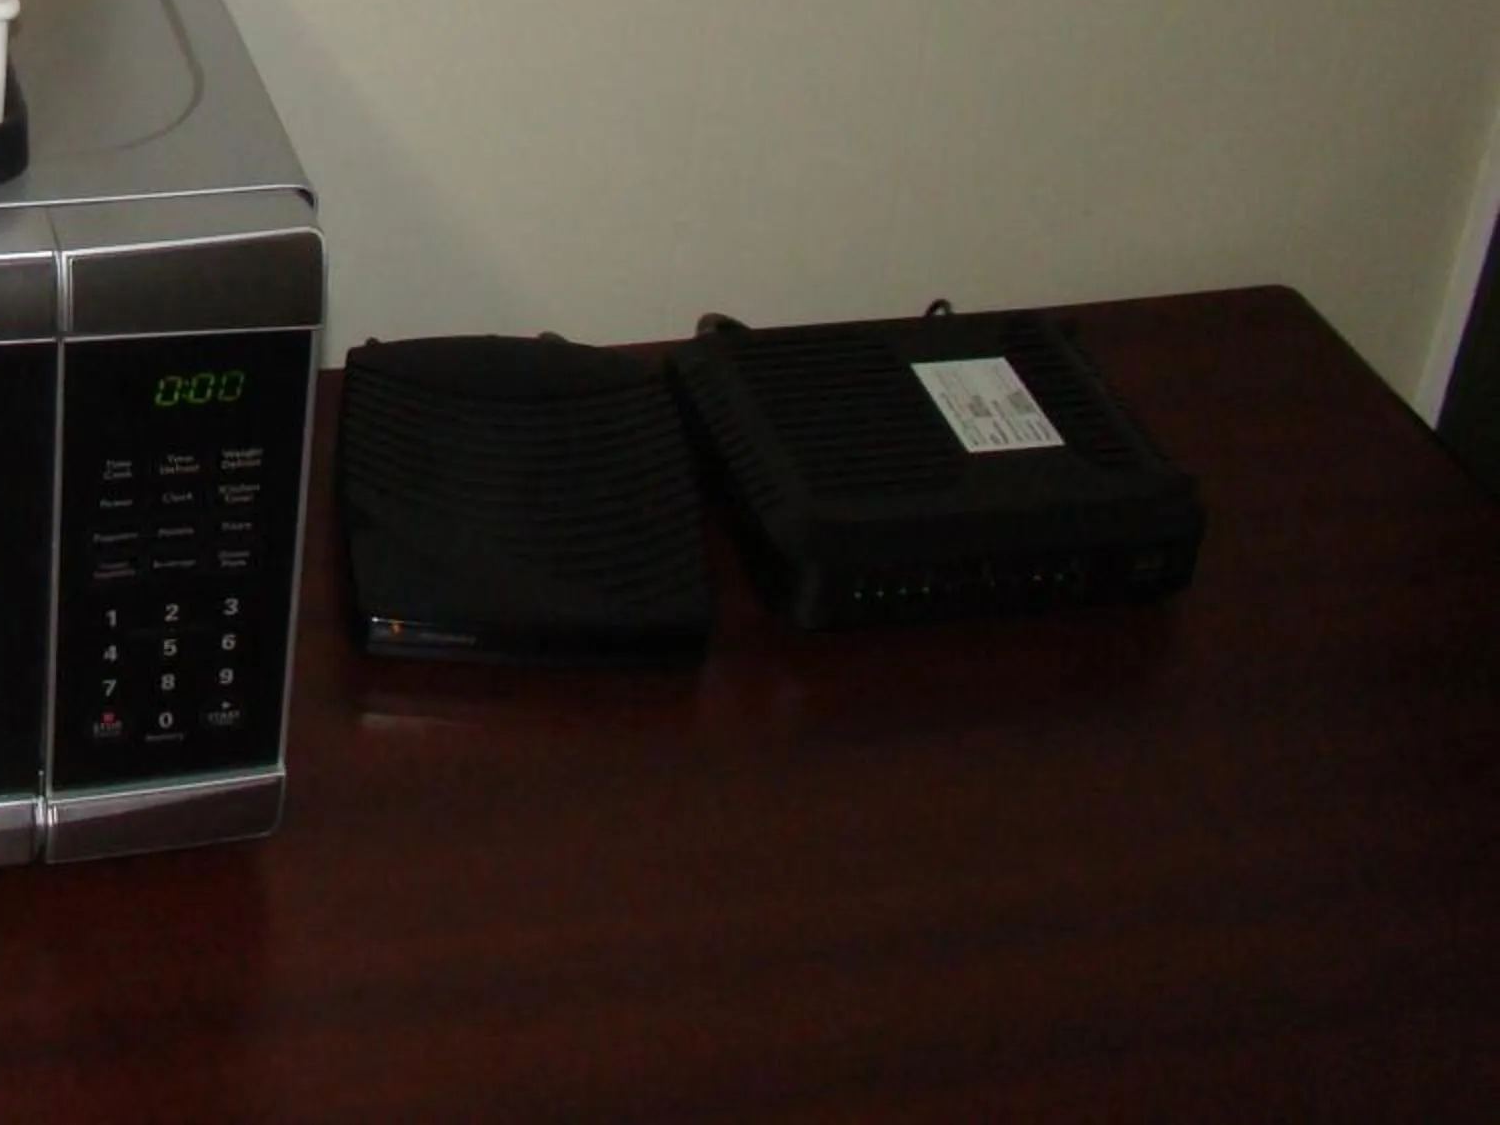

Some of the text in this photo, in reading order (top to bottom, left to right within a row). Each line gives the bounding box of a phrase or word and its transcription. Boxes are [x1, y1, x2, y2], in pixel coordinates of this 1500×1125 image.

[155, 368, 246, 407] 0:00
[164, 603, 180, 622] 2
[222, 597, 240, 616] 3
[105, 609, 117, 628] 1
[163, 638, 178, 657] 5
[221, 632, 237, 651] 6
[102, 644, 118, 662] 4
[160, 673, 176, 691] 8
[218, 667, 235, 685] 9
[101, 678, 117, 697] 7
[158, 711, 174, 729] 0
